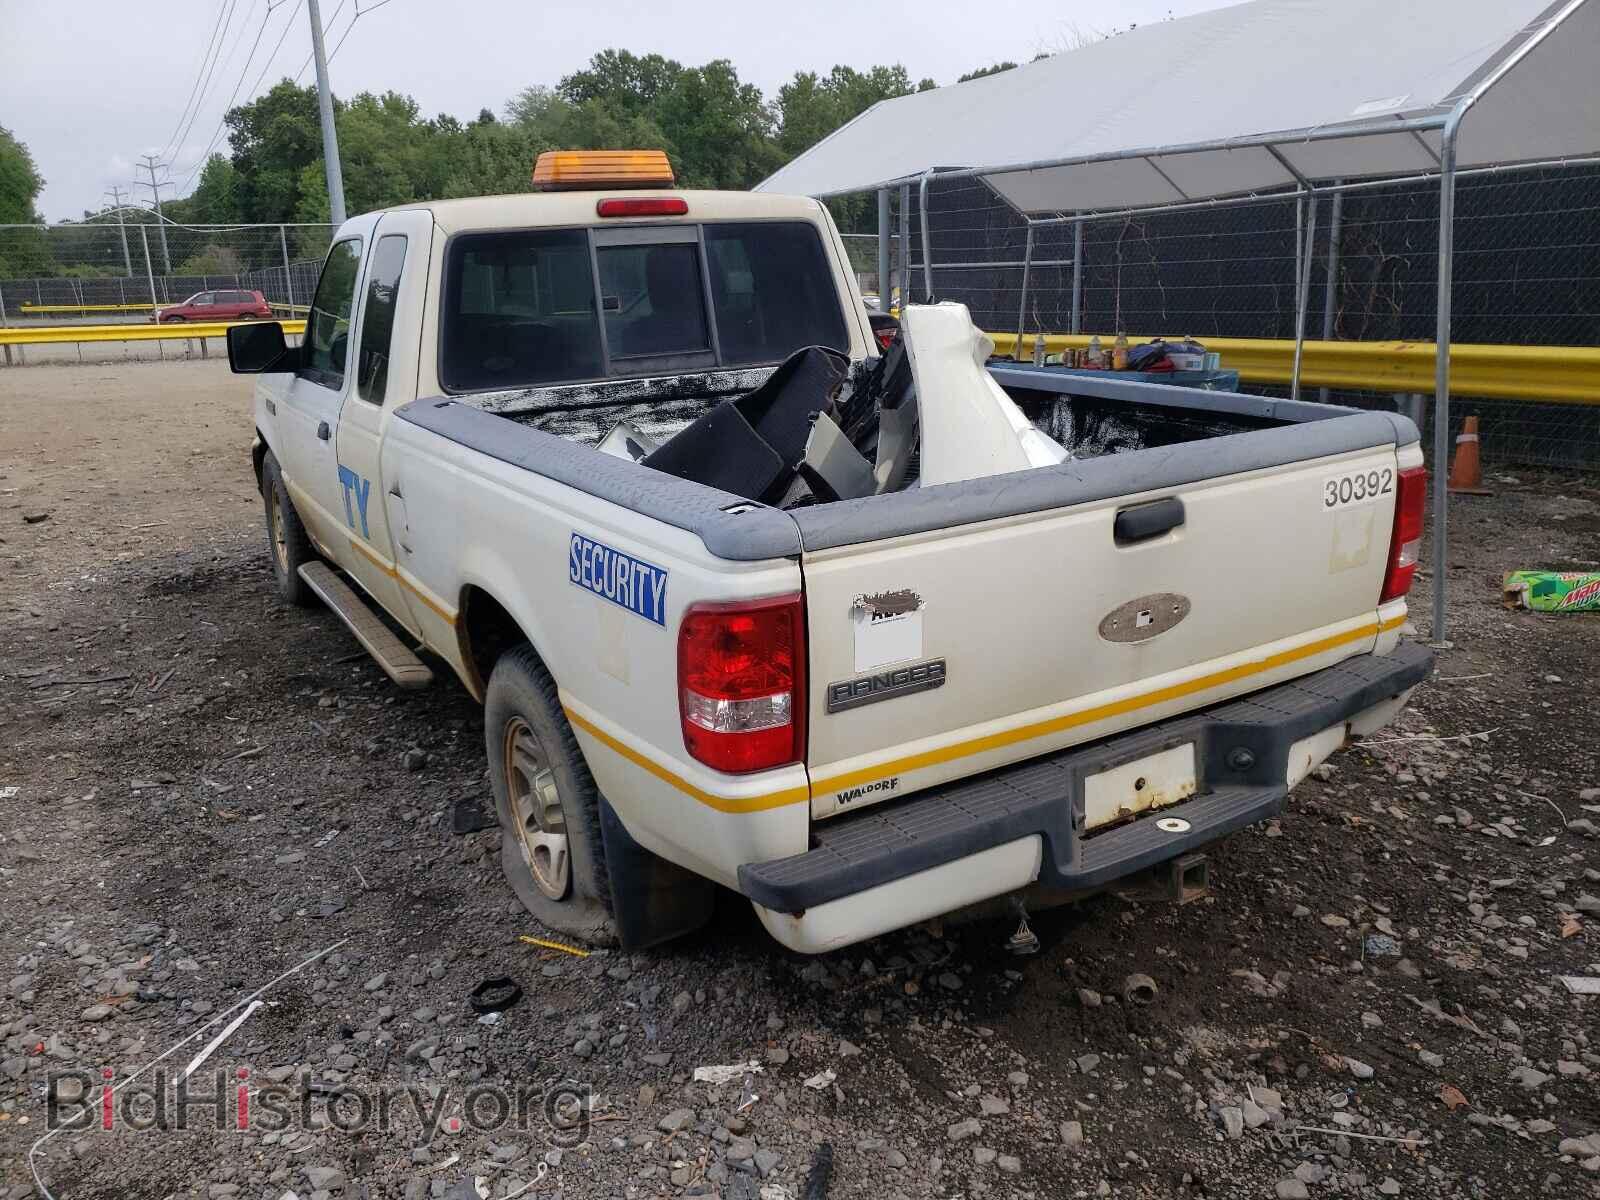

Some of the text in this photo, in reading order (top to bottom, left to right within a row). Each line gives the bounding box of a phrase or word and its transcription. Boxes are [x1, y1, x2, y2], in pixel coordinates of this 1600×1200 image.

[337, 463, 370, 540] TY
[1325, 468, 1393, 507] 30392
[570, 535, 667, 622] SECURITY
[831, 662, 944, 702] RANGER
[837, 778, 899, 805] WALDORF
